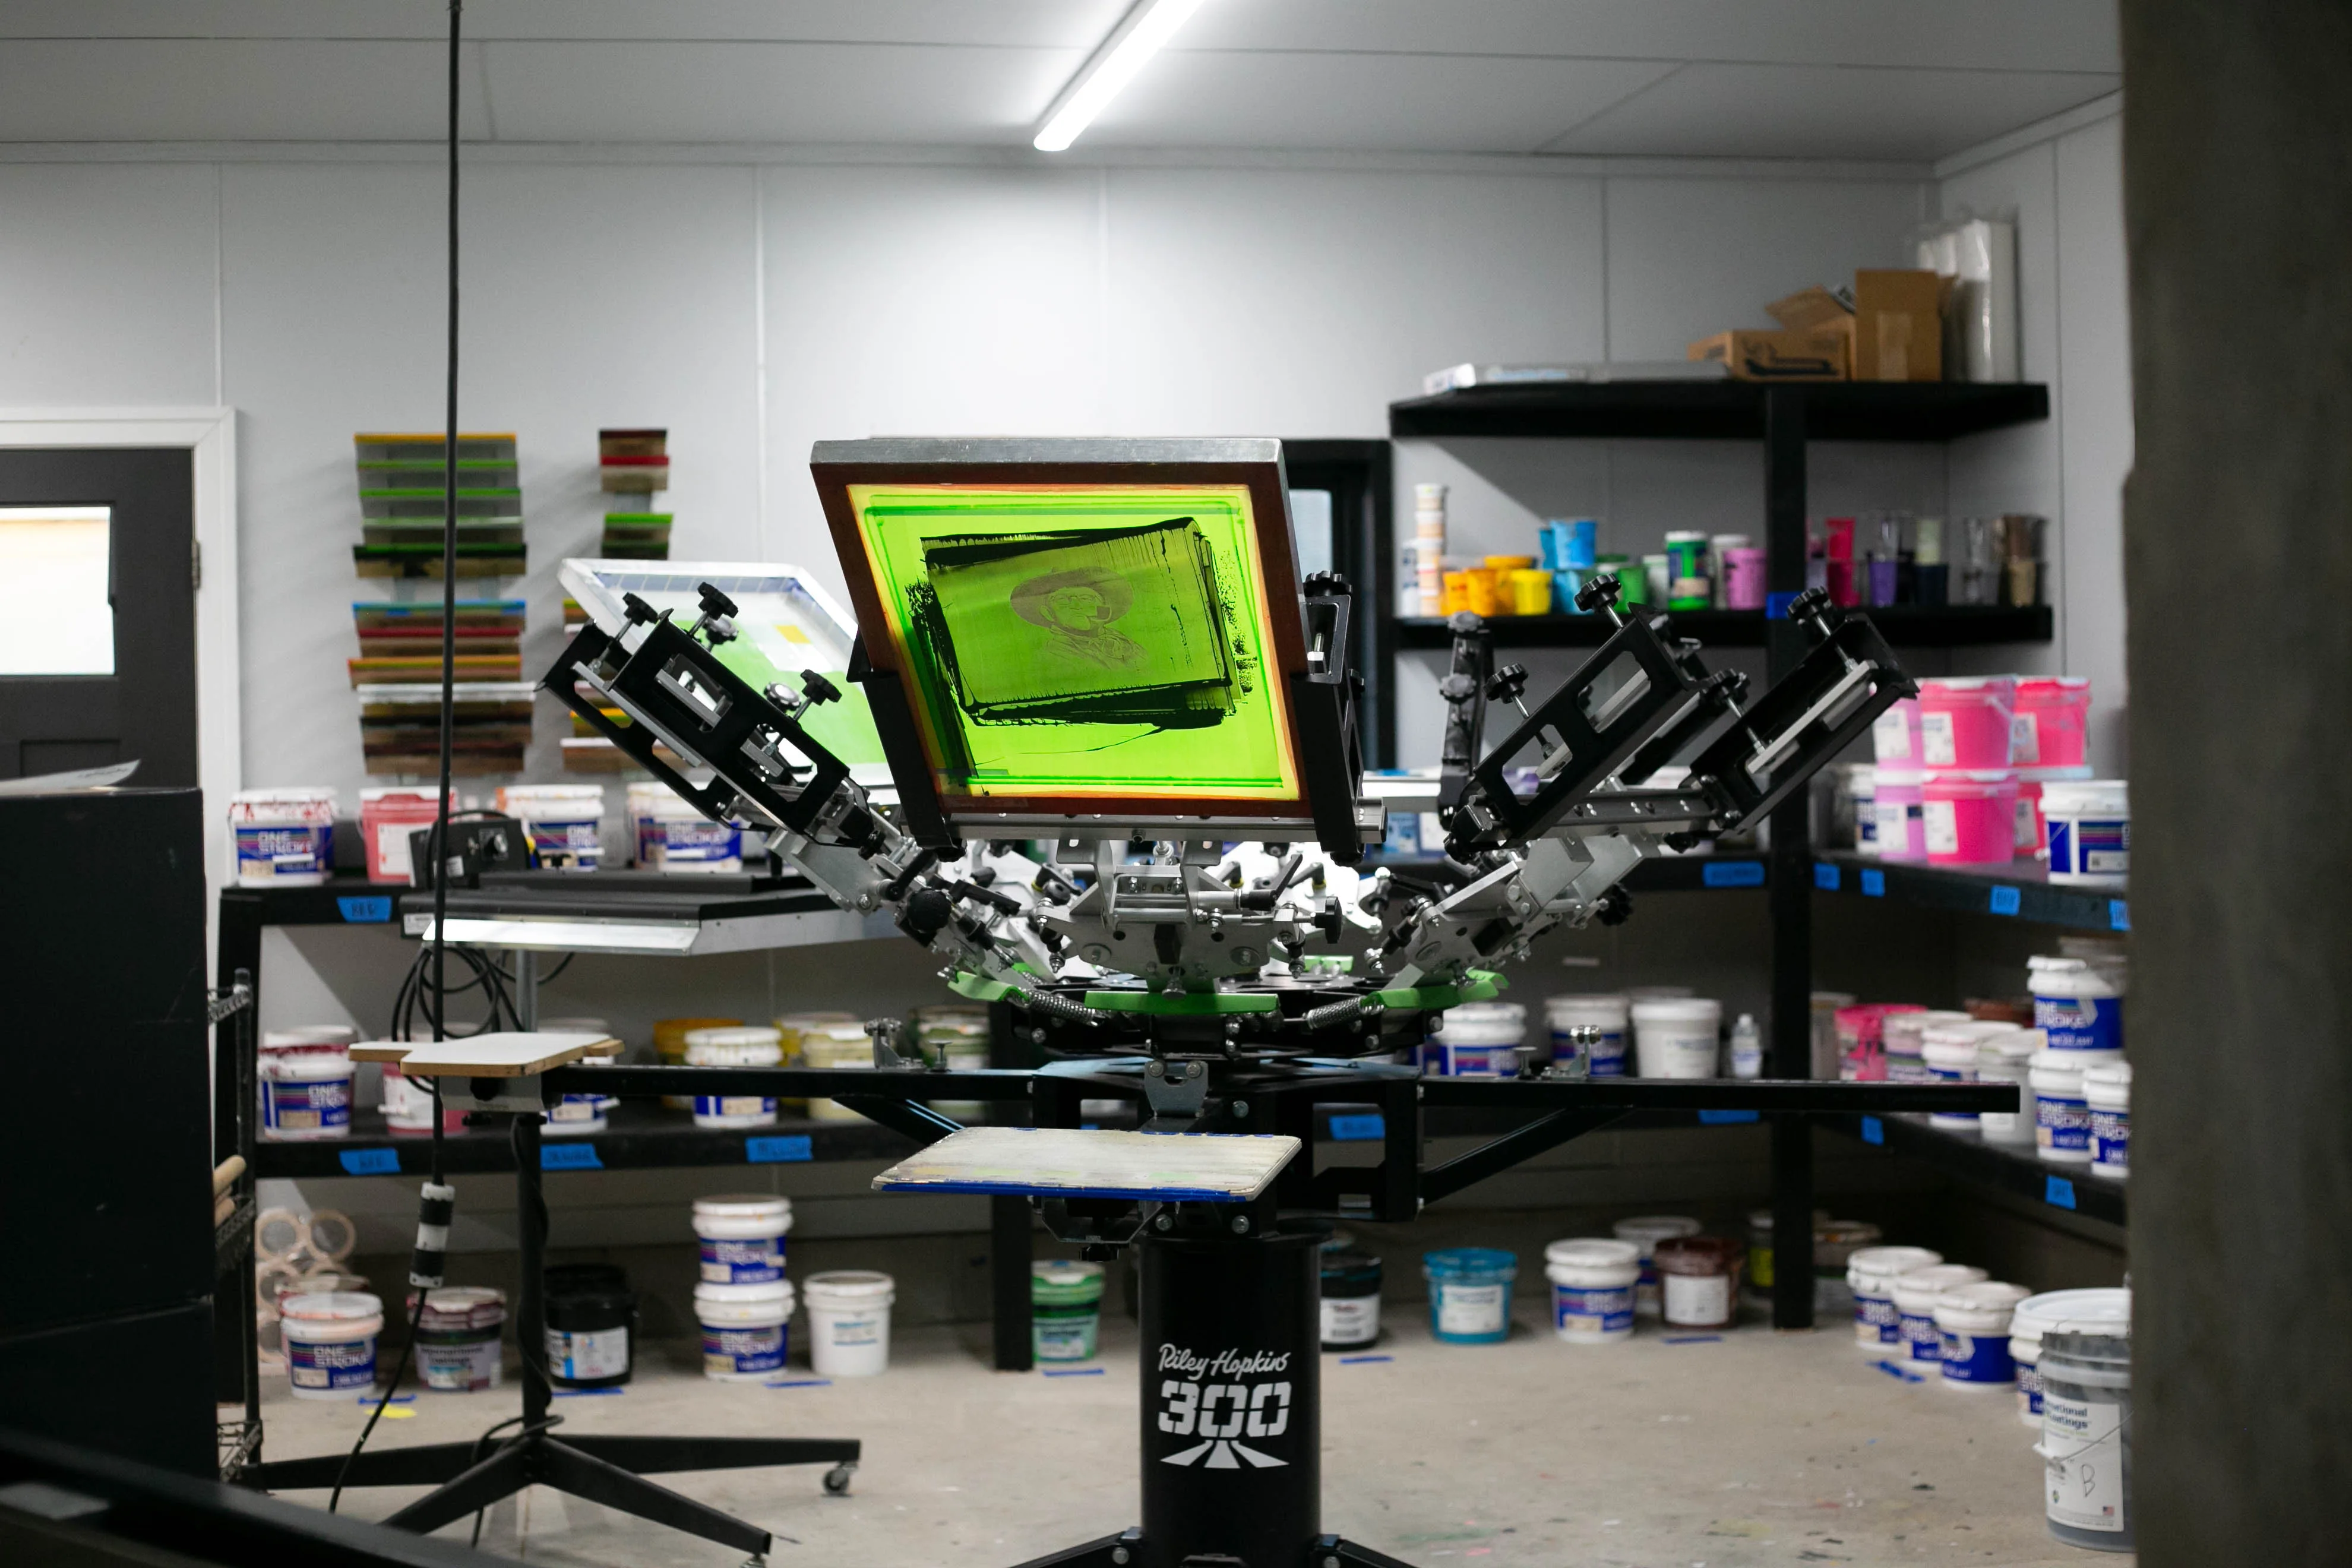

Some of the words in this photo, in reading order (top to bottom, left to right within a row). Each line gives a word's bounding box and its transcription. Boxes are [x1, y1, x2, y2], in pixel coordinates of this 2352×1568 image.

[314, 1345, 346, 1356] ONE
[314, 1355, 368, 1369] STROKE
[1159, 1343, 1210, 1380] Riley
[1210, 1348, 1291, 1381] Hopkins
[1158, 1379, 1292, 1438] 300
[2081, 1463, 2096, 1498] B
